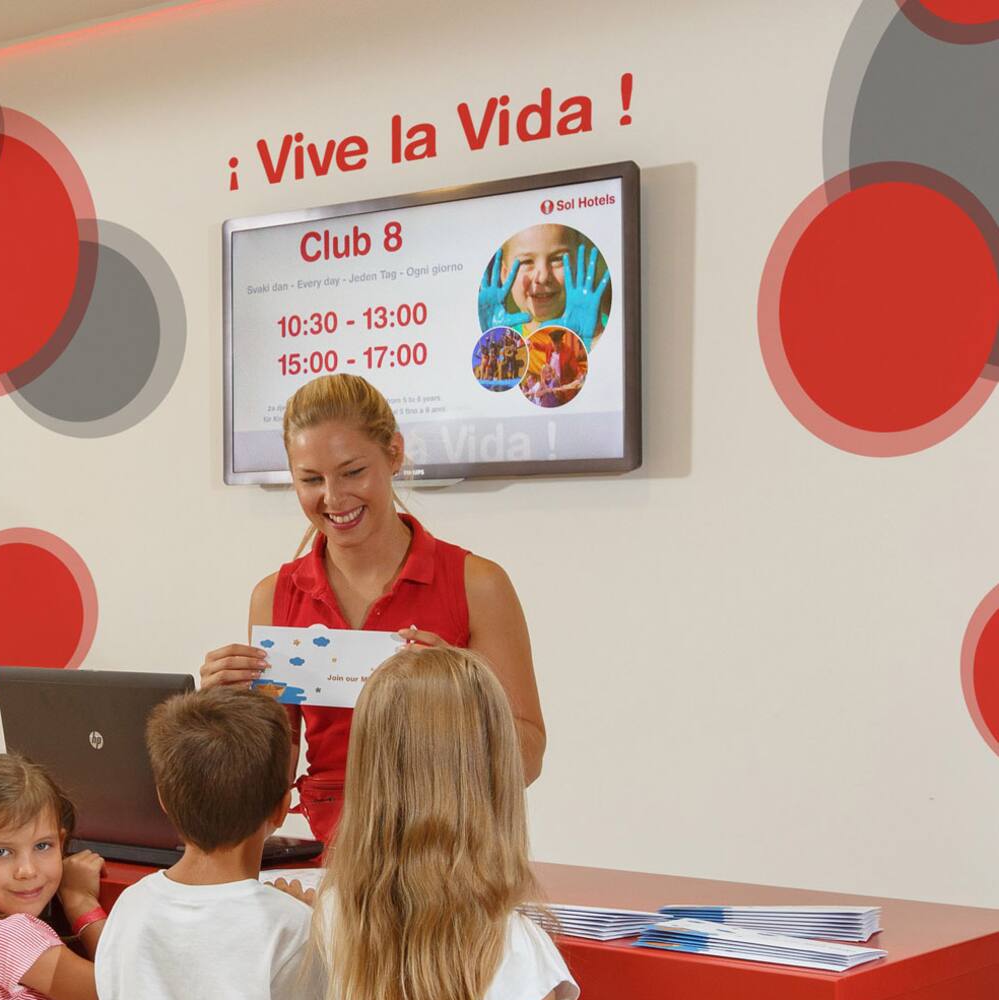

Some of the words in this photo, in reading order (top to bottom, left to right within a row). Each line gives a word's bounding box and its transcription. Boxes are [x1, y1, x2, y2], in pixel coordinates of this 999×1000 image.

[256, 132, 369, 185] Vive
[391, 113, 437, 165] la
[457, 86, 593, 151] Vida
[556, 198, 575, 212] Sol
[578, 193, 616, 209] Hotels
[300, 225, 372, 263] Club
[383, 220, 403, 253] 8
[272, 282, 288, 292] dan
[297, 278, 321, 290] Every
[324, 275, 340, 287] day
[348, 271, 377, 283] Jeden
[380, 269, 397, 281] Tag
[406, 265, 429, 278] Ogni
[432, 263, 464, 276] giorno
[277, 310, 339, 338] 10:30
[363, 302, 428, 330] 13:00
[277, 350, 339, 377] 15:00
[363, 341, 428, 369] 17:00
[441, 422, 532, 464] Vida
[89, 730, 104, 750] hp
